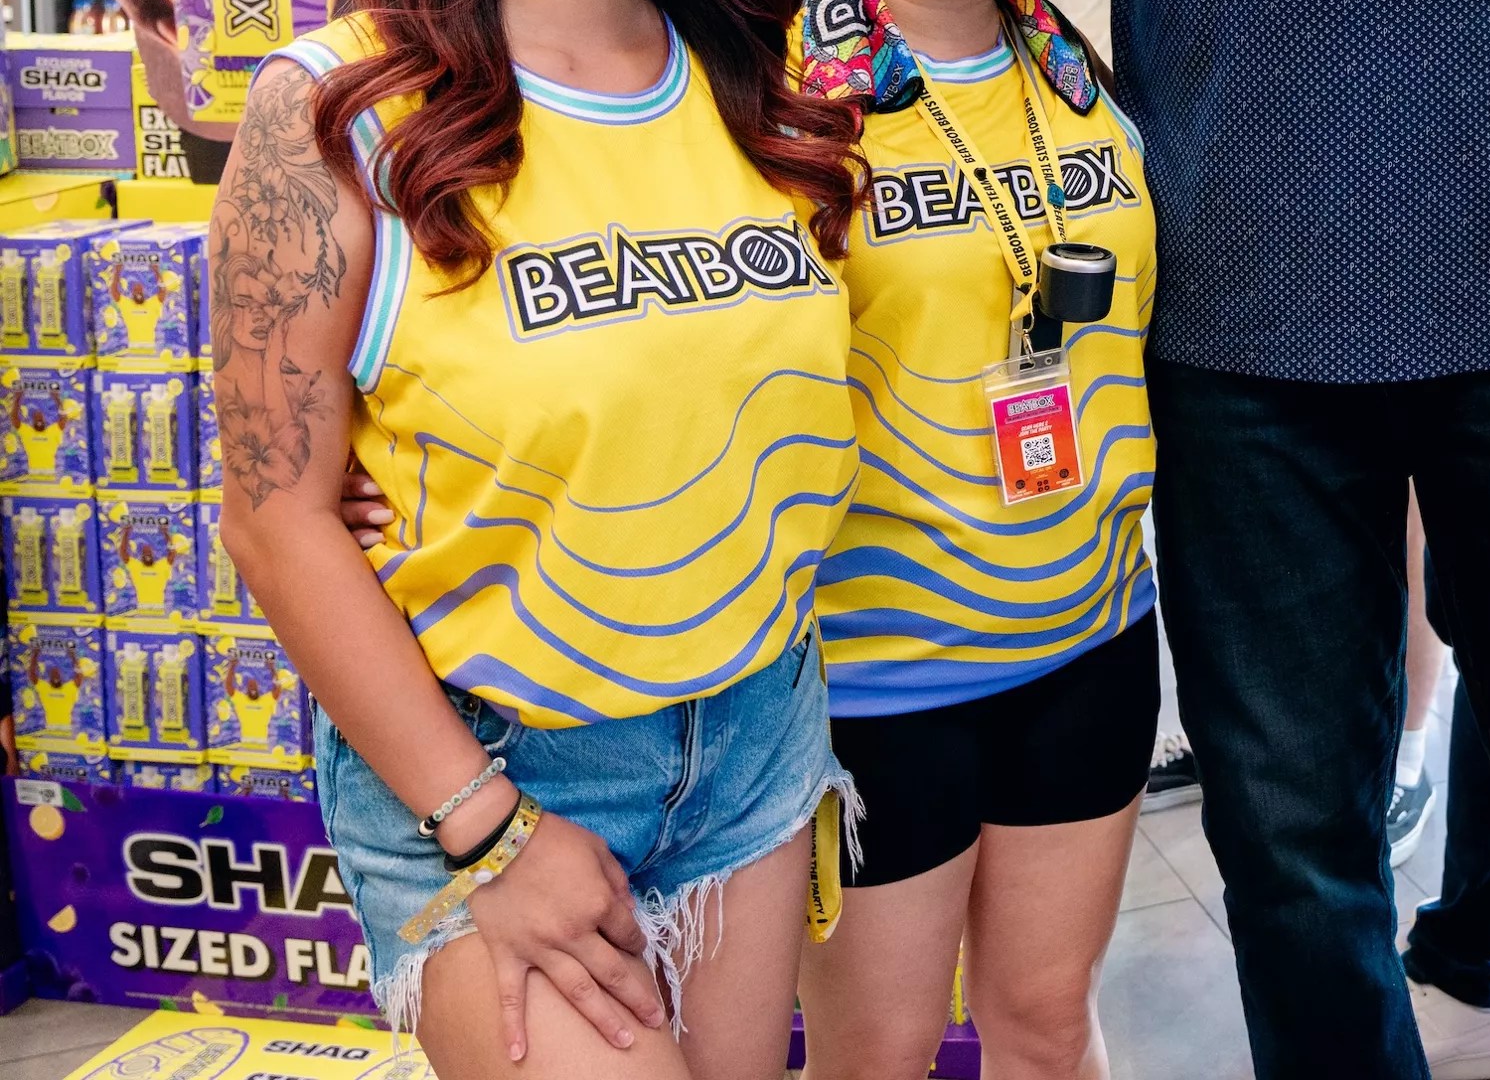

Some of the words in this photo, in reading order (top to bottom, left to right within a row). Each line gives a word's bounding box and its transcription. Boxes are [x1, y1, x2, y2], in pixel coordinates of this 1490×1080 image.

[24, 69, 101, 88] SHAQ
[20, 128, 117, 159] BEATBOX
[925, 100, 951, 131] BEATS
[943, 125, 977, 164] BEATBOX
[1032, 134, 1049, 164] BEATS
[993, 201, 1016, 233] BEATS
[1006, 232, 1033, 278] BEATBOX
[508, 220, 834, 332] BEATBOX
[810, 881, 825, 915] PARTY
[109, 922, 274, 980] SIZED
[264, 1039, 372, 1061] SHAQ
